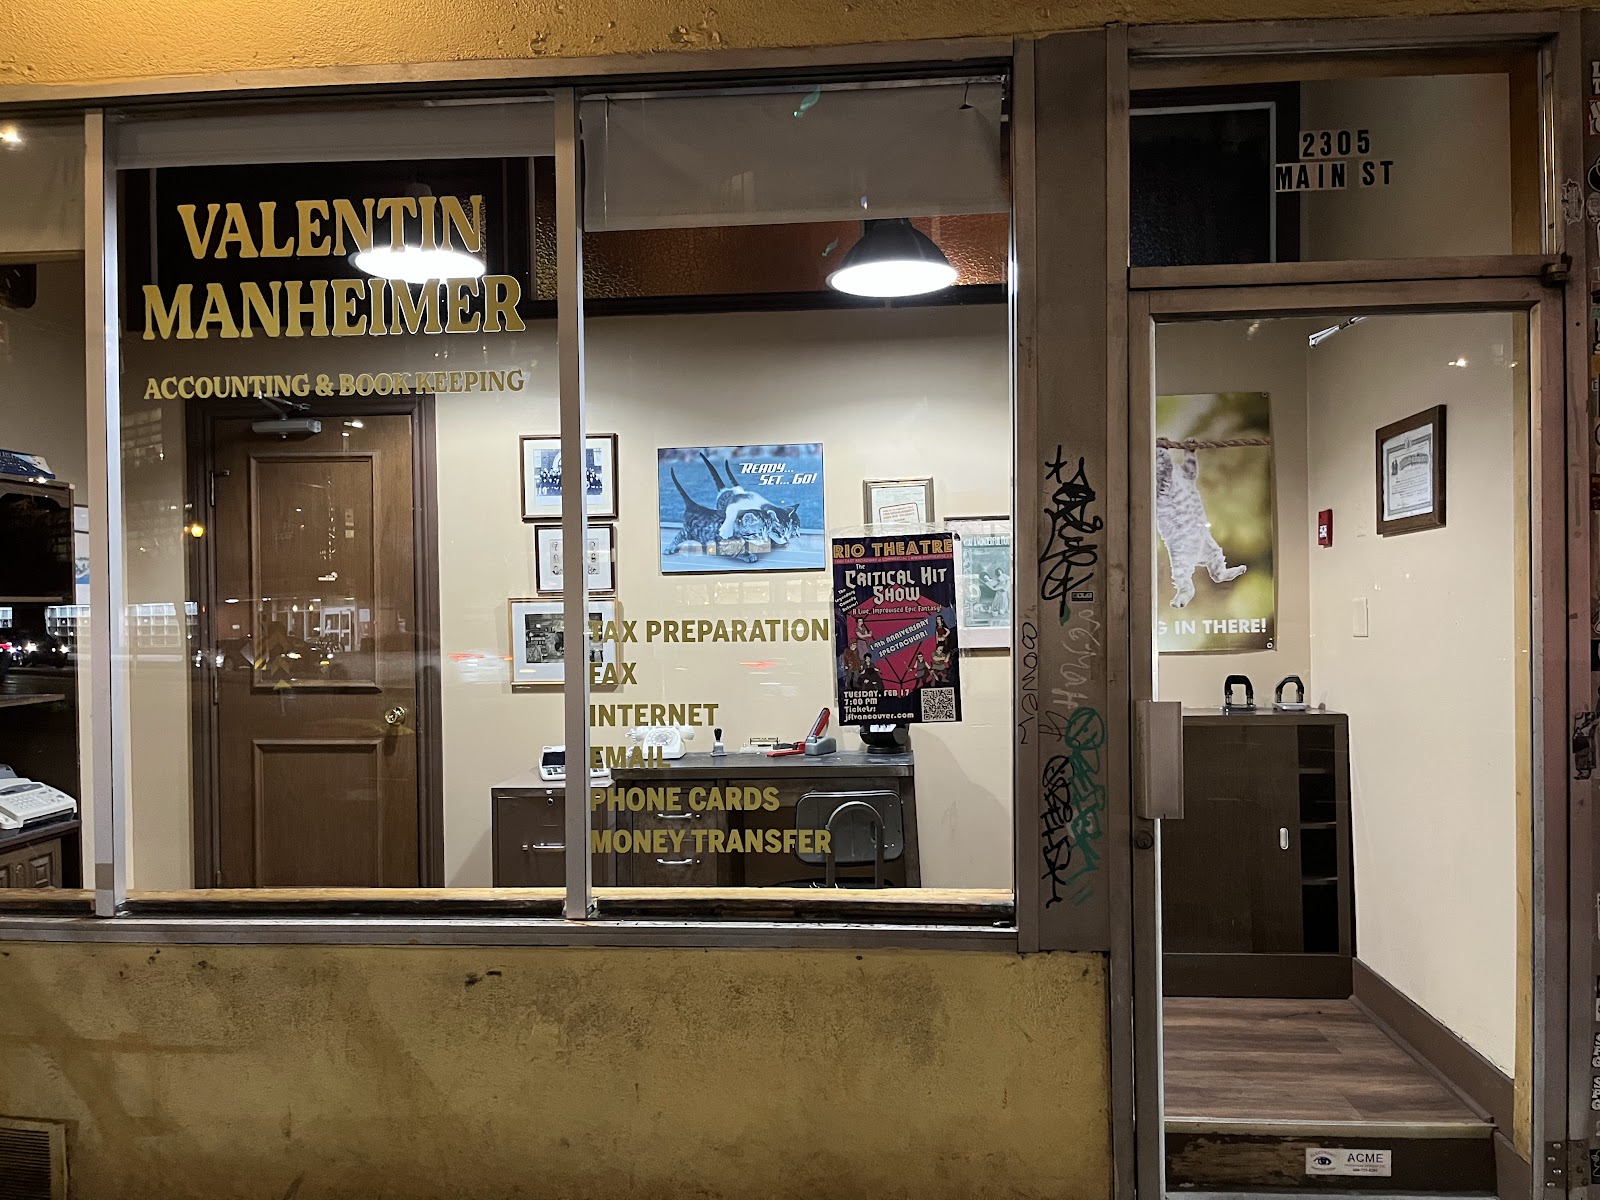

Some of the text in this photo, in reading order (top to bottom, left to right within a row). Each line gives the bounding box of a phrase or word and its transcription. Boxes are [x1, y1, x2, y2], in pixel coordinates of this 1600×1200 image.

[1303, 129, 1370, 157] 2305
[1276, 160, 1394, 190] MAIN ST
[177, 195, 483, 260] VALENTIN
[142, 274, 526, 341] MANHEIMER
[143, 368, 525, 400] ACCOUNTING & BOOK KEEPING
[792, 472, 818, 485] GO!
[833, 543, 866, 559] RIO
[871, 538, 953, 557] THEATRE
[845, 566, 948, 589] CRITICAL HIT
[873, 585, 920, 605] SHOW
[872, 606, 904, 615] Improvised
[904, 604, 917, 613] Epic
[917, 603, 943, 613] Fantasy!
[588, 618, 829, 643] TAX PREPARATION
[885, 619, 930, 643] ANNIVERSARY
[1174, 620, 1196, 635] IN
[1202, 617, 1267, 635] THERE!
[879, 630, 929, 658] SPECTACULAR!
[590, 662, 638, 685] FAX
[844, 697, 878, 706] 7:00 PM
[883, 689, 898, 697] FEB
[900, 688, 910, 697] 17
[590, 703, 719, 727] INTERNET
[844, 705, 877, 713] Tickets:
[590, 746, 671, 769] EMAIL
[590, 786, 780, 812] PHONE CARDS
[591, 829, 832, 854] MONEY TRANSFER
[1347, 1152, 1384, 1163] ACME
